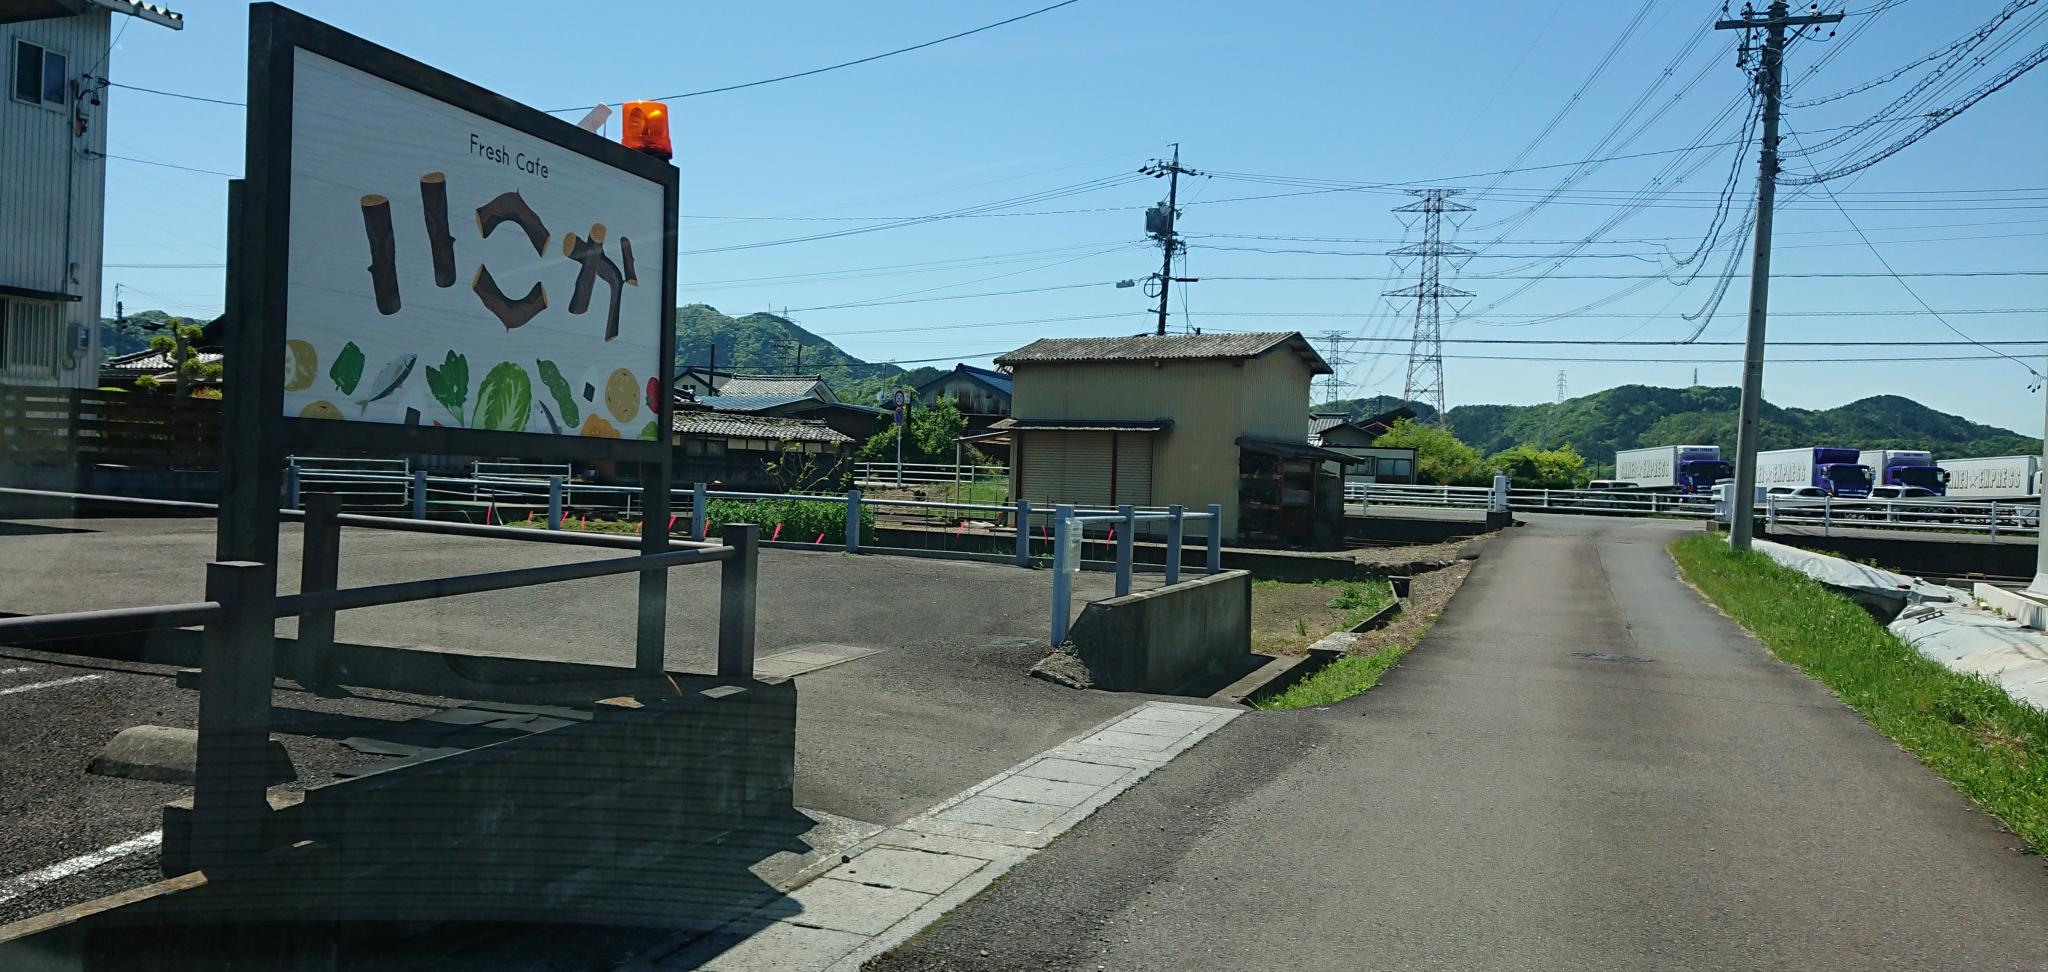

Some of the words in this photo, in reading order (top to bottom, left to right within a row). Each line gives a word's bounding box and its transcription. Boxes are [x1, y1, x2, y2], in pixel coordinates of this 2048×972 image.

[470, 132, 510, 166] Fresh
[516, 152, 549, 179] Cafe
[1773, 462, 1806, 483] EXPRESS
[1979, 467, 2021, 489] EXPRESS
